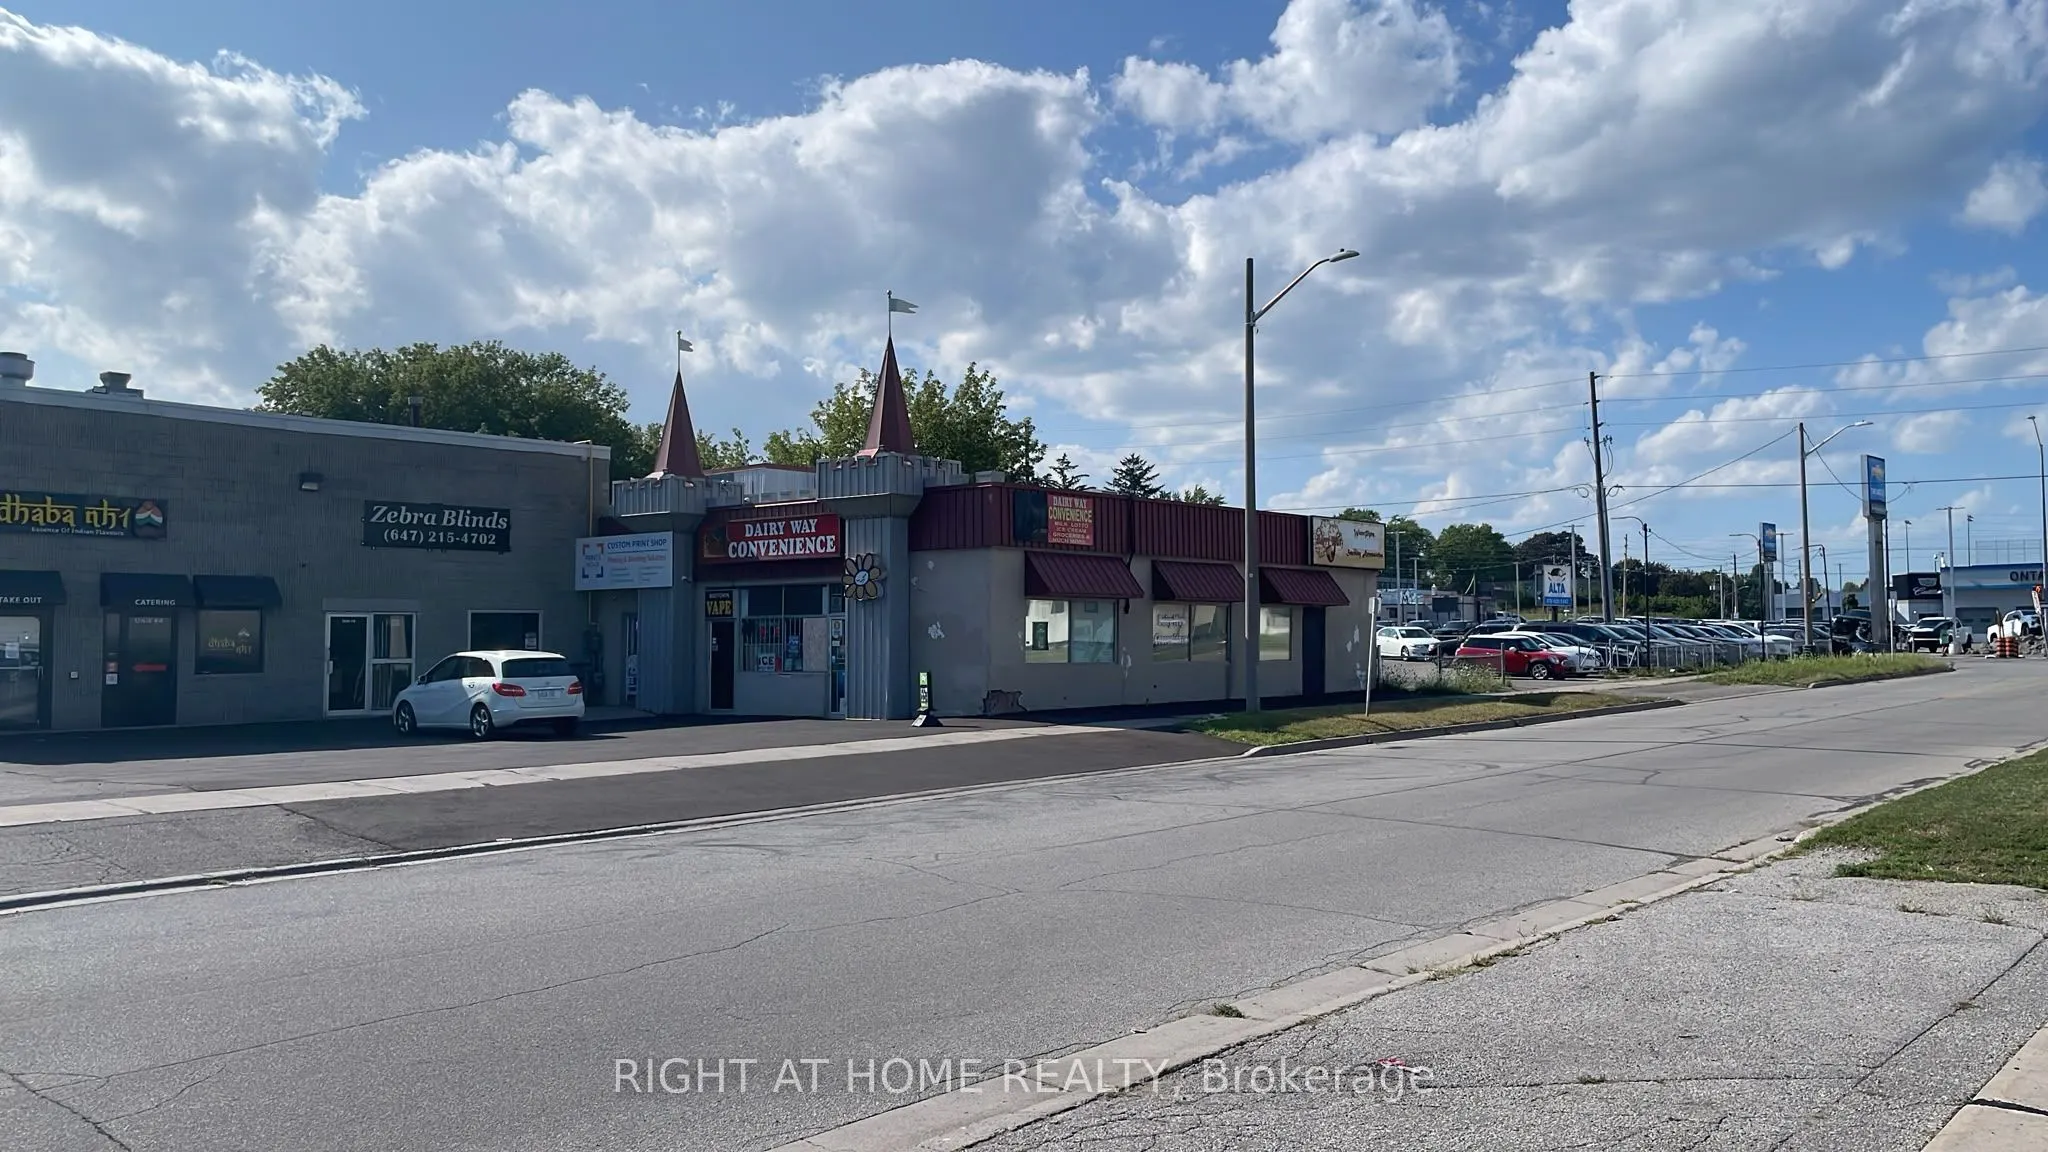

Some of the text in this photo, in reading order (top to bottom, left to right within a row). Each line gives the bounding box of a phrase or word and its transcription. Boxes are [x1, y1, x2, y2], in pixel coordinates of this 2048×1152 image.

[1053, 496, 1087, 509] DAIRY WAY
[370, 505, 508, 530] Zebra Blinds
[1048, 507, 1093, 523] CONVENIENCE
[745, 518, 818, 537] DAIRY WAY
[384, 528, 496, 545] (647) 215-4702
[607, 538, 667, 550] CUSTOM PRINT SHOP
[728, 535, 836, 558] CONVENIENCE
[1548, 582, 1566, 594] ALTA
[23, 596, 42, 604] OUT
[134, 598, 176, 606] CATERING
[707, 600, 731, 616] VAPE
[758, 656, 774, 666] ICE
